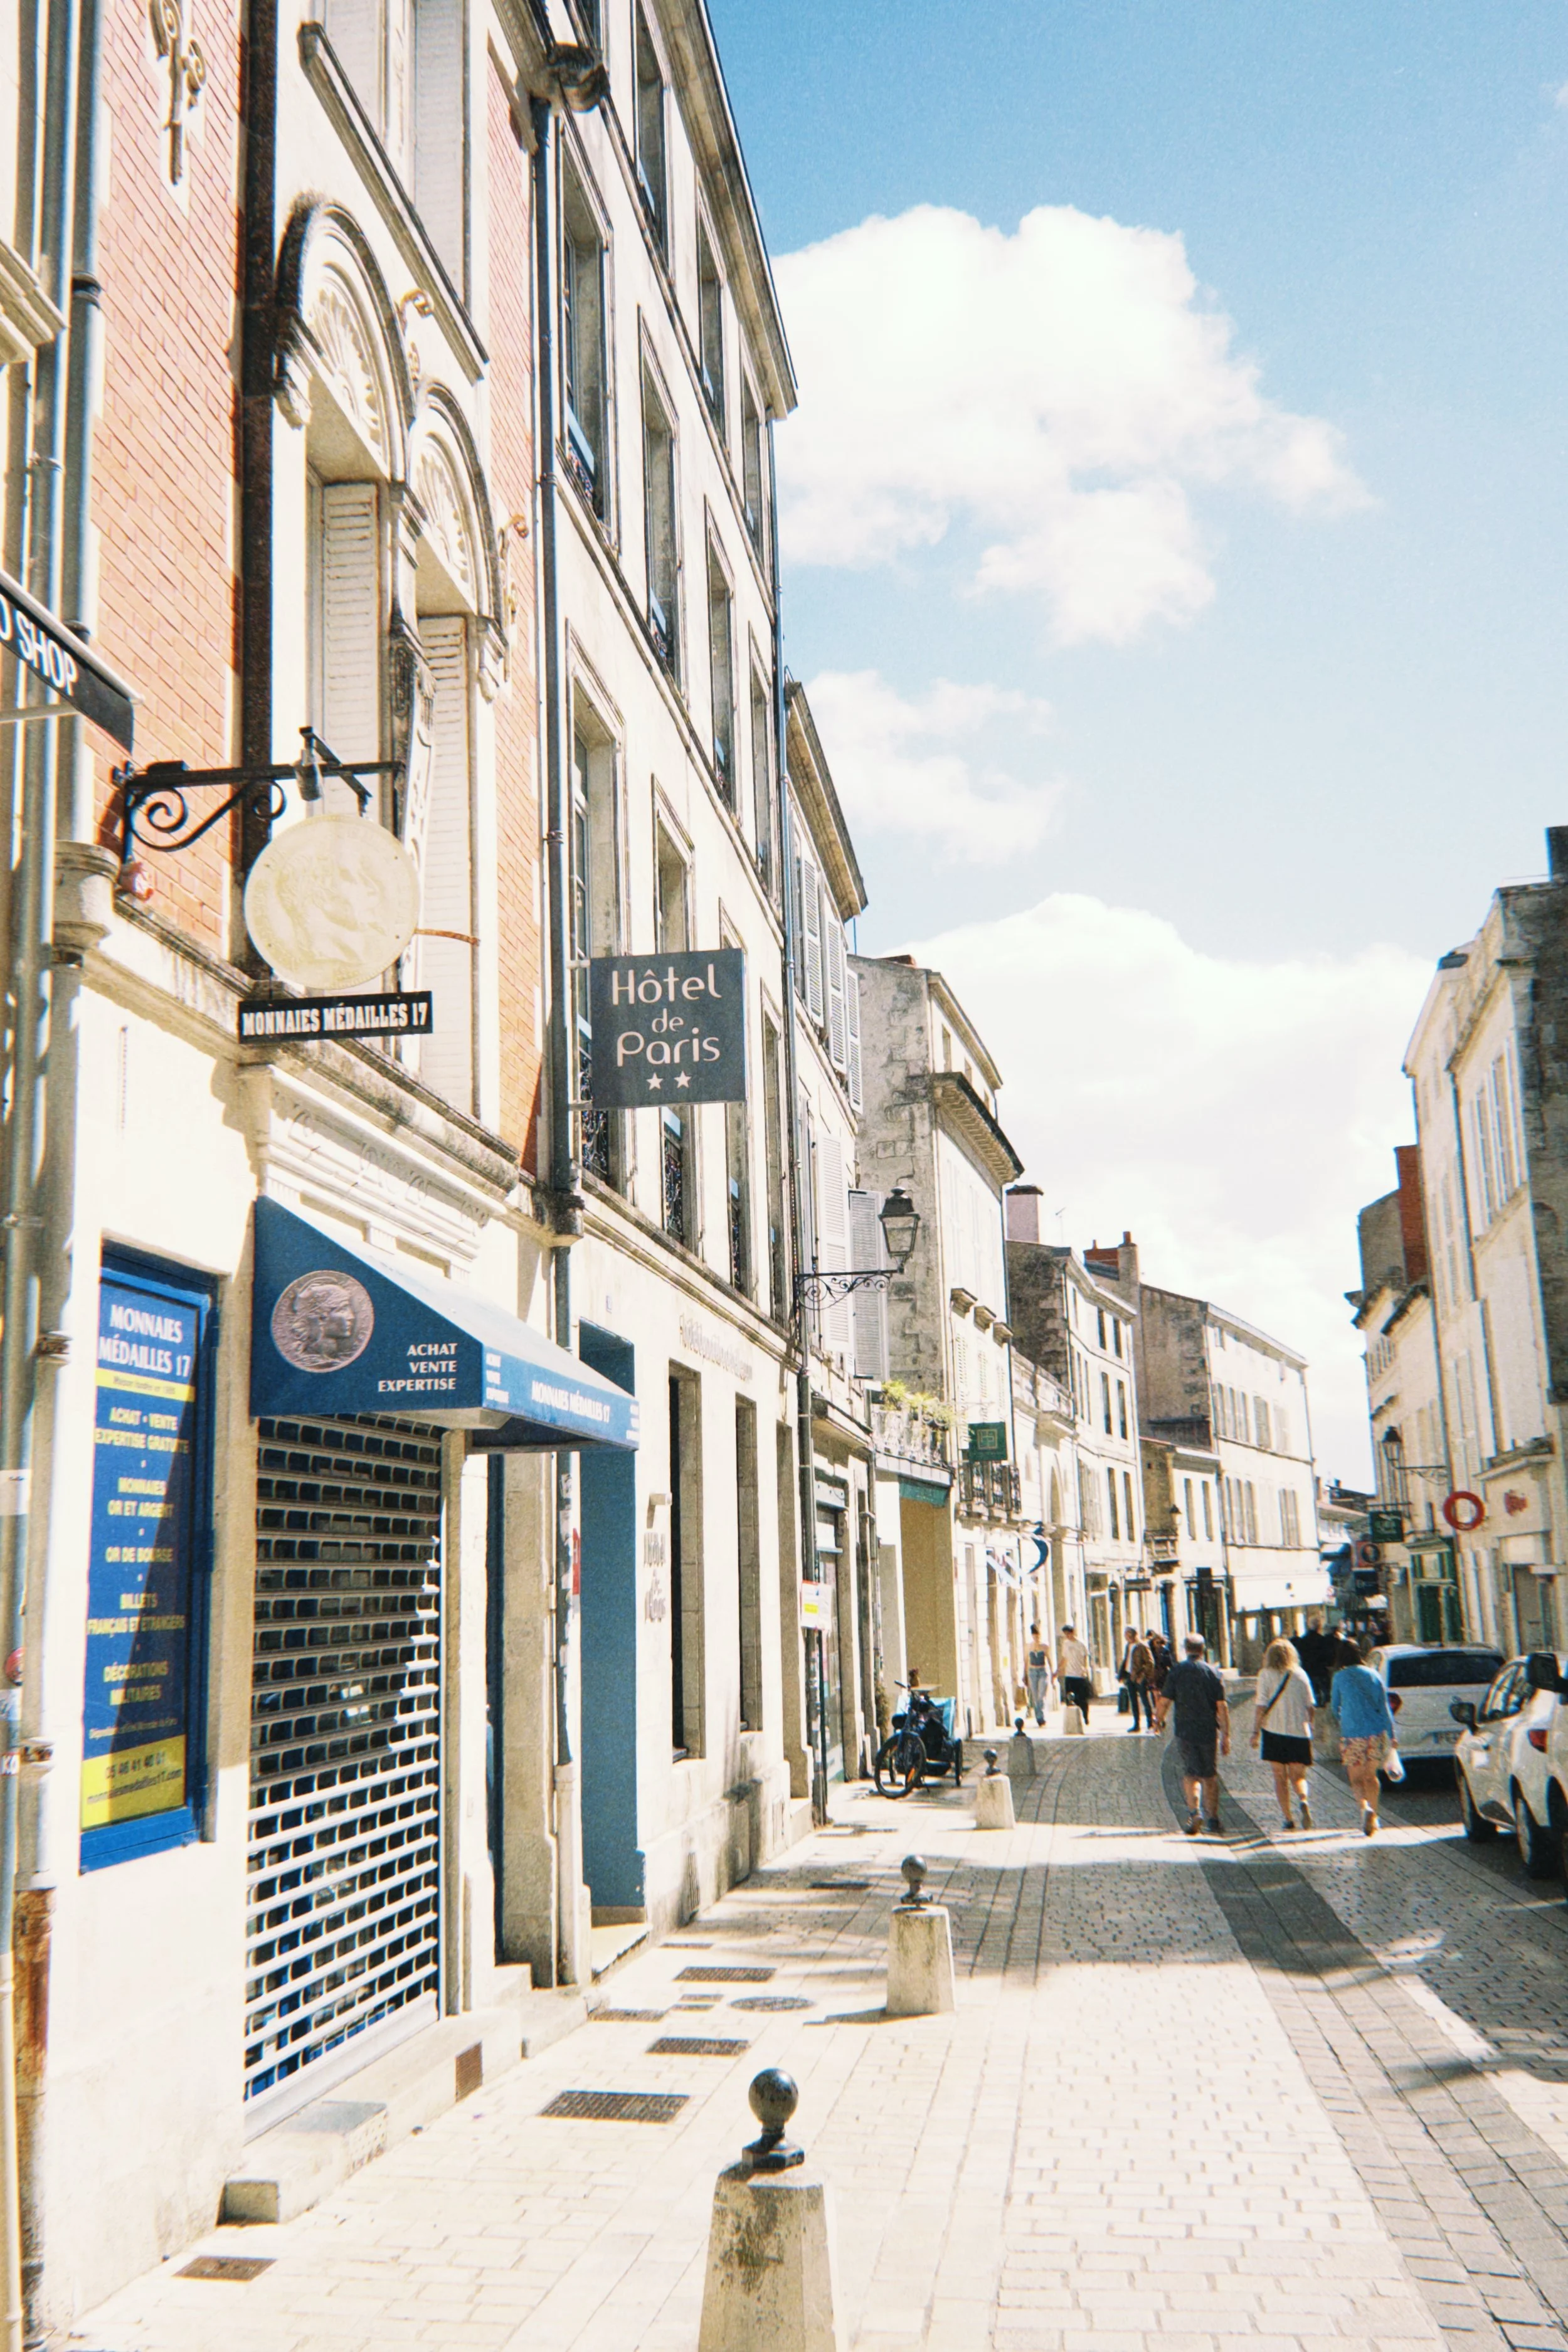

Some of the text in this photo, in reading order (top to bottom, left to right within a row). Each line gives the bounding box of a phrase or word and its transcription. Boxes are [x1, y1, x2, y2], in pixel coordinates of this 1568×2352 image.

[13, 607, 78, 697] SHOP
[612, 963, 722, 1005] Hôtel
[242, 1002, 428, 1036] MONNAIES MÉDAILLES 17
[652, 1008, 684, 1033] de
[617, 1027, 720, 1067] Paris
[110, 1305, 184, 1343] MONNAIES
[98, 1333, 191, 1377] MÉDAILLES 17
[407, 1343, 458, 1356] ACHAT
[409, 1360, 458, 1374] VENTE
[378, 1378, 457, 1392] EXPERTISE
[95, 1428, 147, 1449] EXPERTISE
[124, 1500, 138, 1517] ET
[122, 1546, 136, 1563] DE
